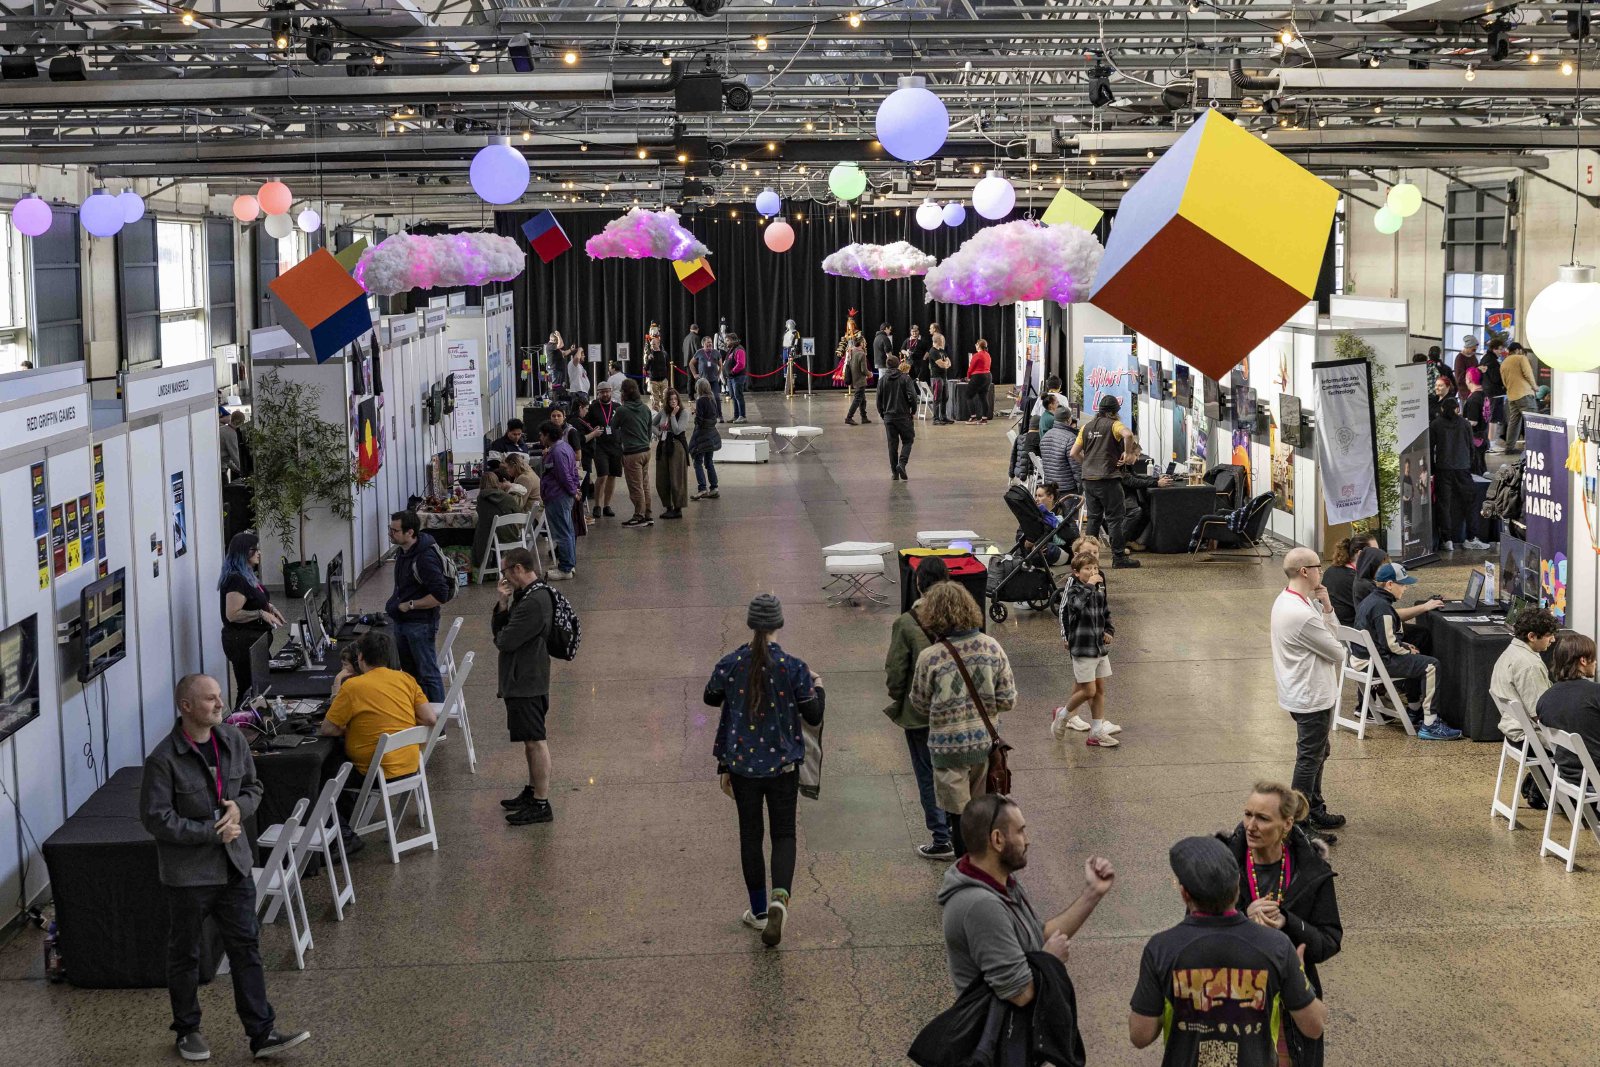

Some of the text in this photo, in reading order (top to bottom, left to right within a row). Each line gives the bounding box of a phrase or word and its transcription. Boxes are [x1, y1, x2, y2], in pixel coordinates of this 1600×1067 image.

[26, 406, 76, 432] RED GRIFFIN GAMES
[1526, 450, 1544, 470] TAS
[1526, 473, 1551, 495] GAME
[1526, 495, 1562, 523] MAKERS
